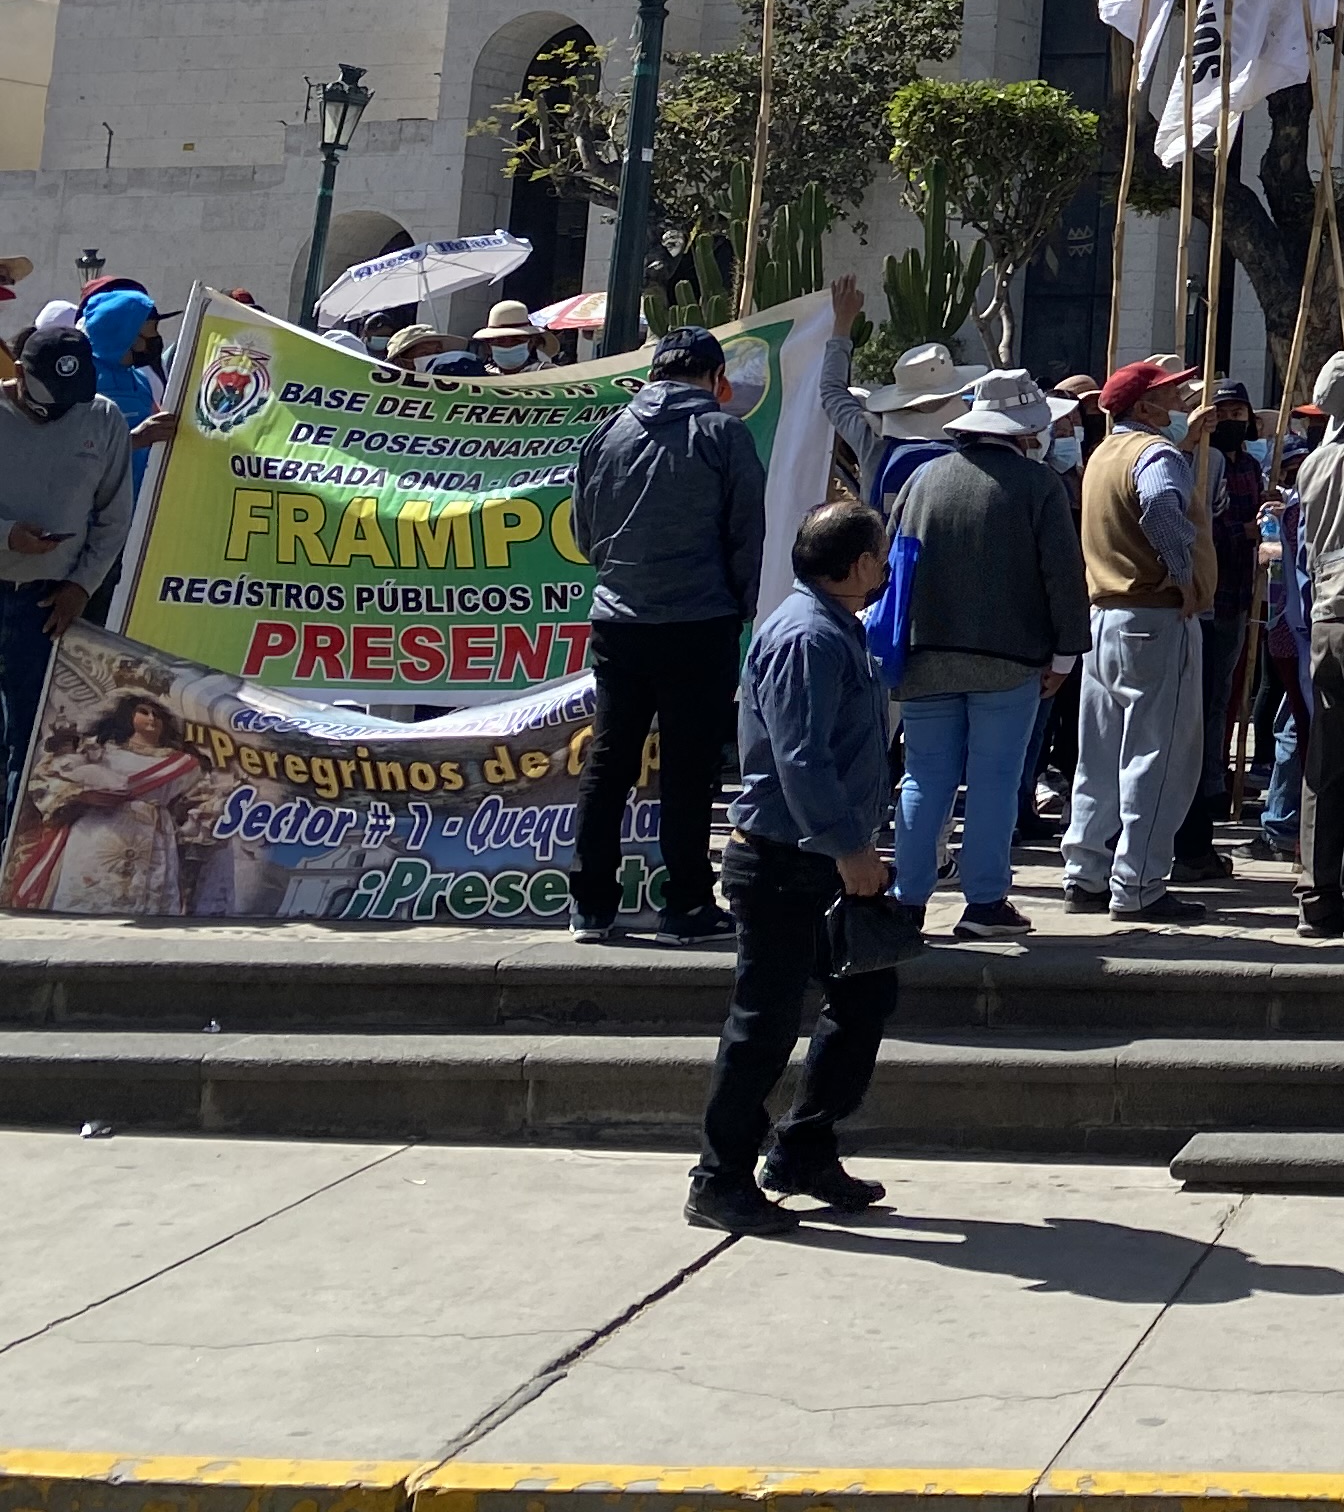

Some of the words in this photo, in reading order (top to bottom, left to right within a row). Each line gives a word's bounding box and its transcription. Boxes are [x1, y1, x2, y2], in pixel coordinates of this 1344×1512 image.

[279, 383, 371, 414] BASE
[376, 399, 437, 421] DEL
[448, 405, 575, 426] FRENTE
[291, 423, 338, 447] DE
[231, 455, 388, 489] QUEBRADA
[399, 469, 483, 491] ONDA
[159, 574, 345, 613] REGÍSTROS
[356, 579, 531, 613] PÚBLICOS
[242, 621, 593, 683] PRESENT
[484, 745, 551, 784] de
[215, 787, 356, 846] Sector
[366, 804, 394, 847] #
